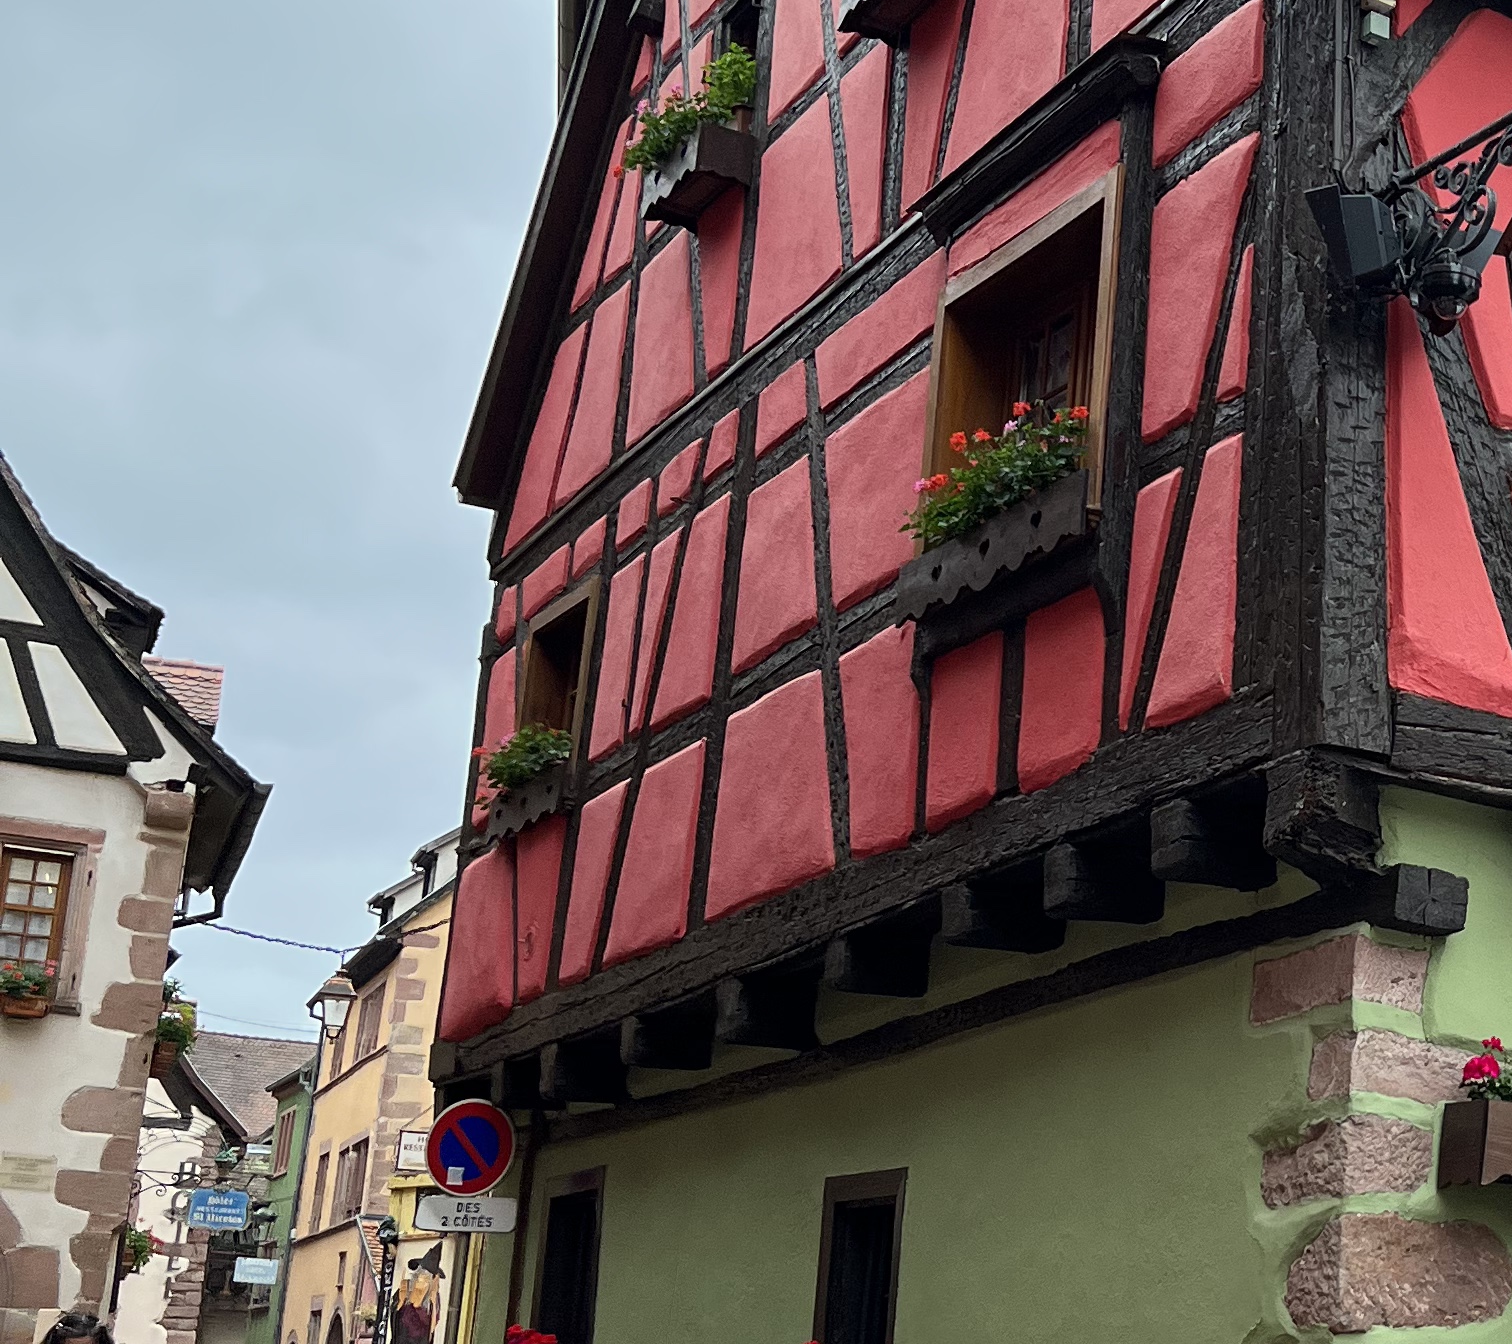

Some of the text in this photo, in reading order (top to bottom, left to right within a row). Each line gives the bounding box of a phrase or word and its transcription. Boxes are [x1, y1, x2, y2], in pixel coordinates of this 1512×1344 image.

[456, 1202, 481, 1213] DES
[441, 1215, 494, 1228] 2 CÔTÉS
